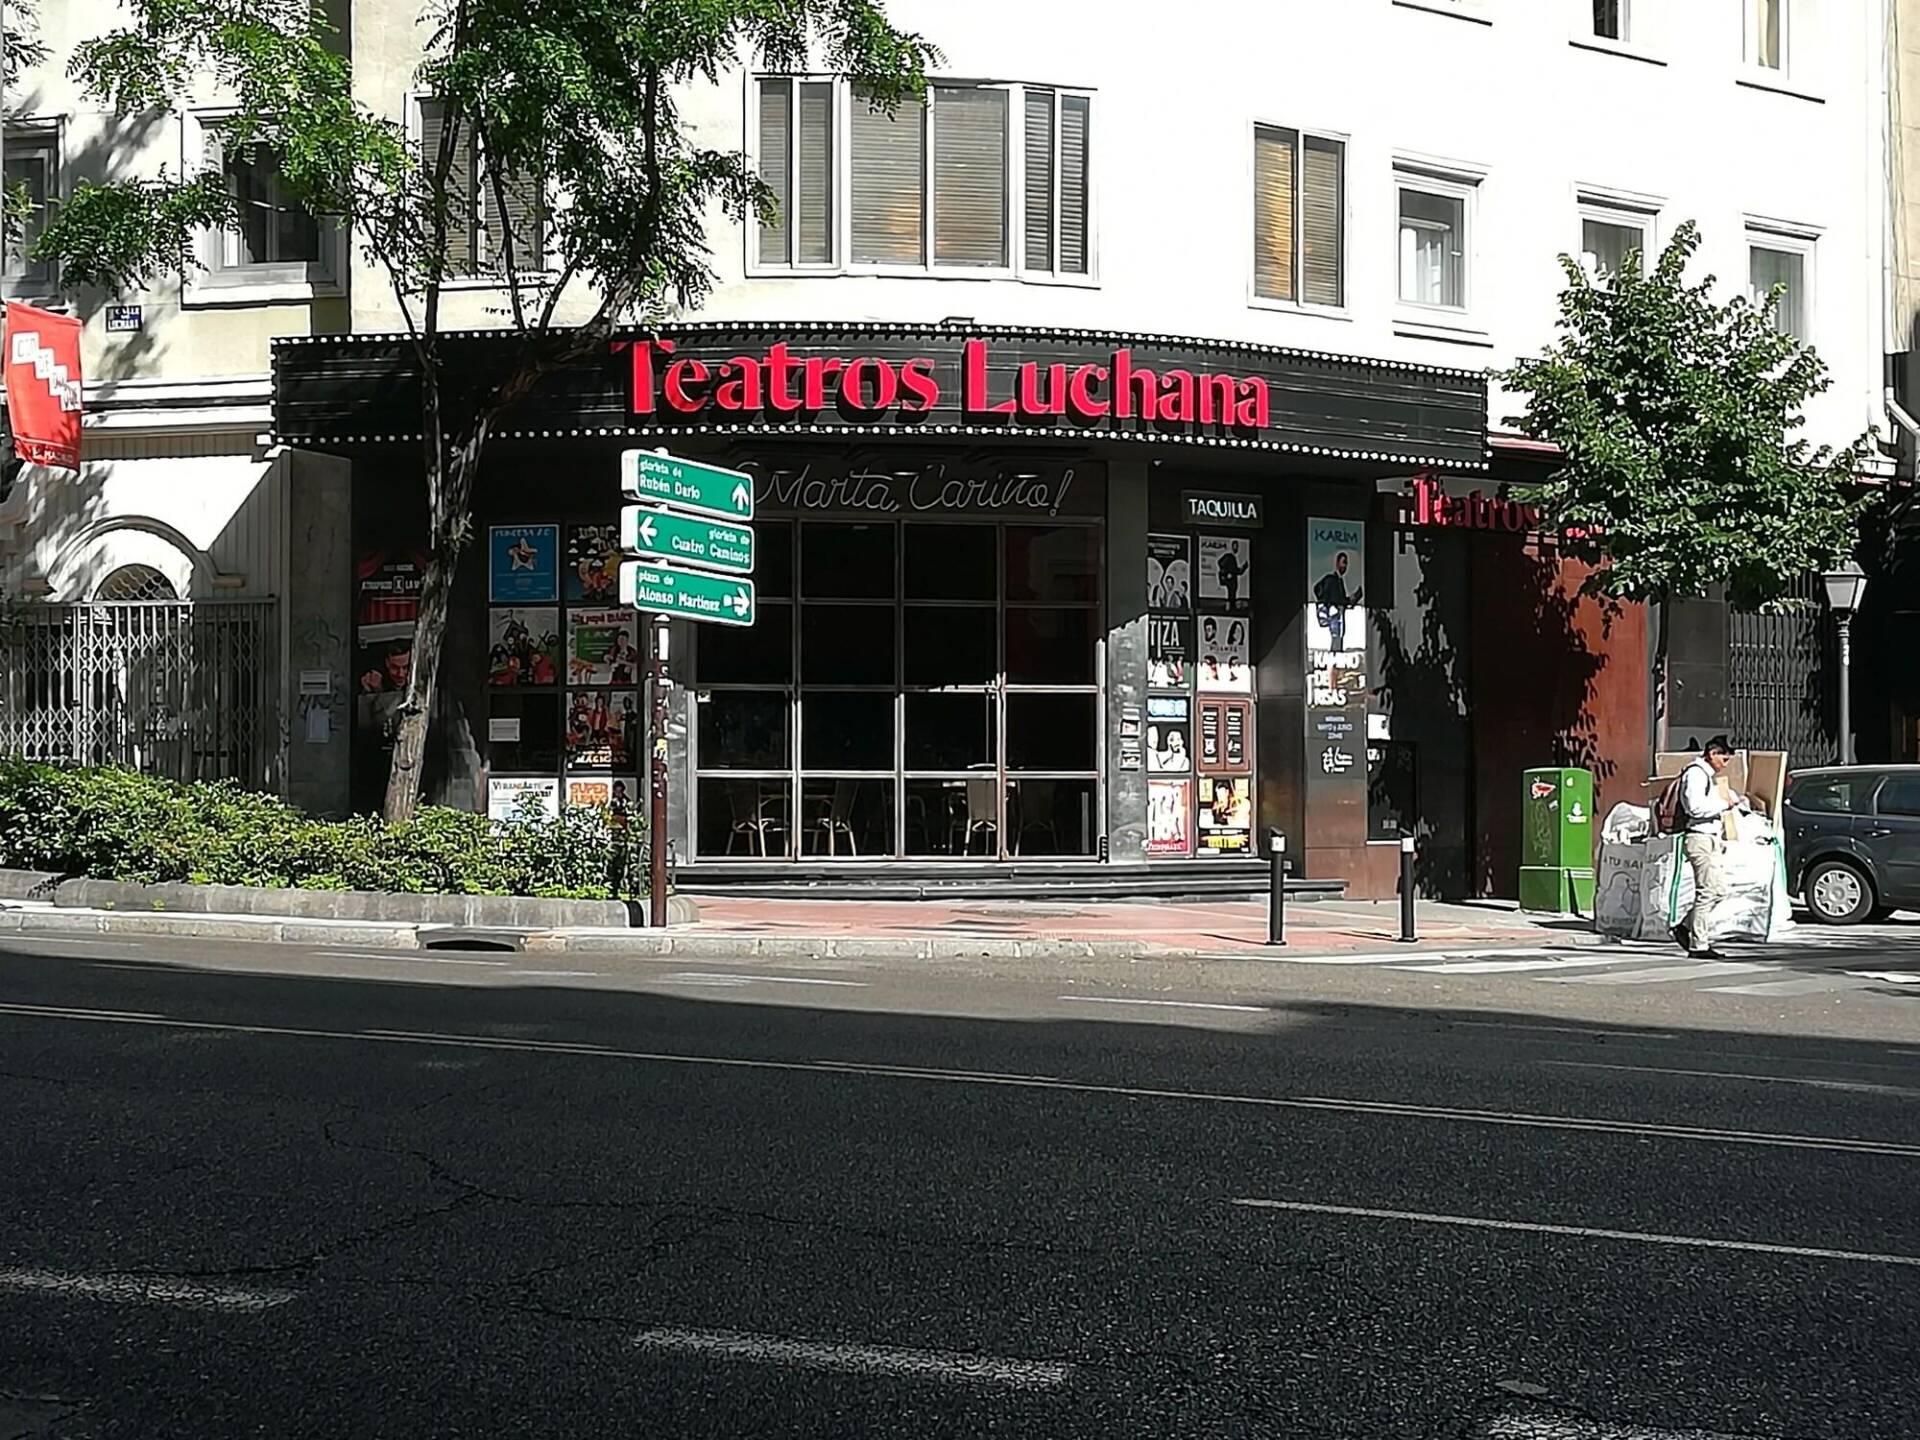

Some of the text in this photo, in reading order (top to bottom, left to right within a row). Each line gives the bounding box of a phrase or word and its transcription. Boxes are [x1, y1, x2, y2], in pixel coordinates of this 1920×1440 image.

[611, 338, 1270, 430] Teatros Luchana
[639, 474, 670, 493] Rubén
[1188, 498, 1257, 519] TAQUILLA
[672, 536, 750, 564] Cuatro Caminos
[638, 586, 673, 605] Alonso
